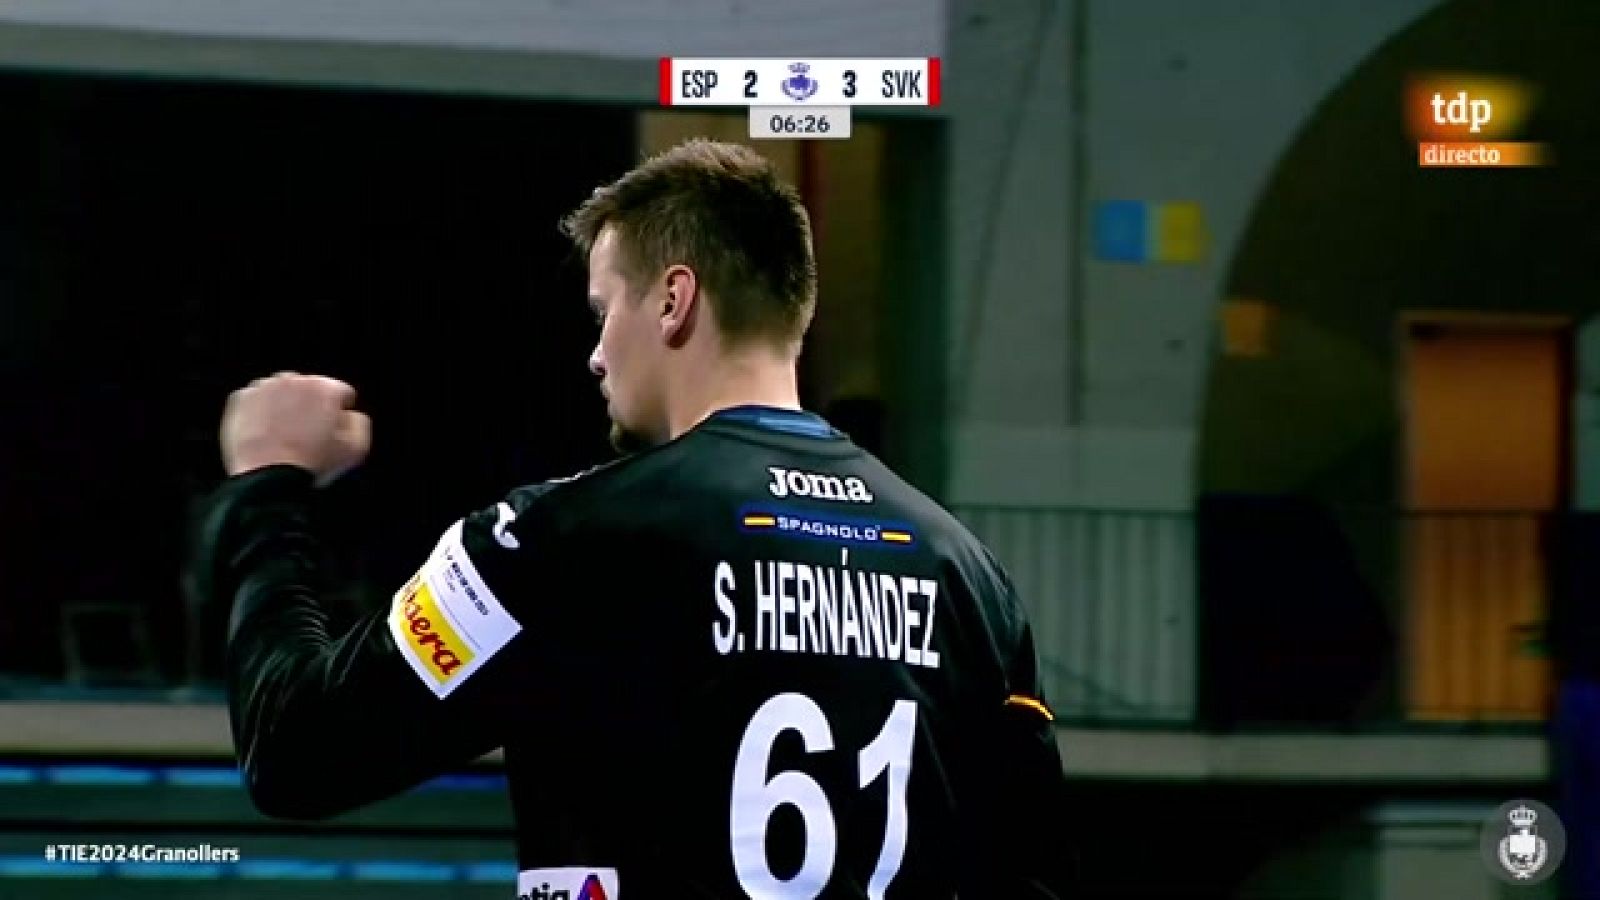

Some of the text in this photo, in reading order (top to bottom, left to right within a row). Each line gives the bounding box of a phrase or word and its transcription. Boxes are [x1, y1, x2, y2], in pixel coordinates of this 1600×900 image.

[767, 466, 874, 503] Joma
[776, 516, 881, 541] SPAGNOLO
[712, 547, 941, 669] S. HERNÁNDEZ
[730, 692, 918, 900] 61
